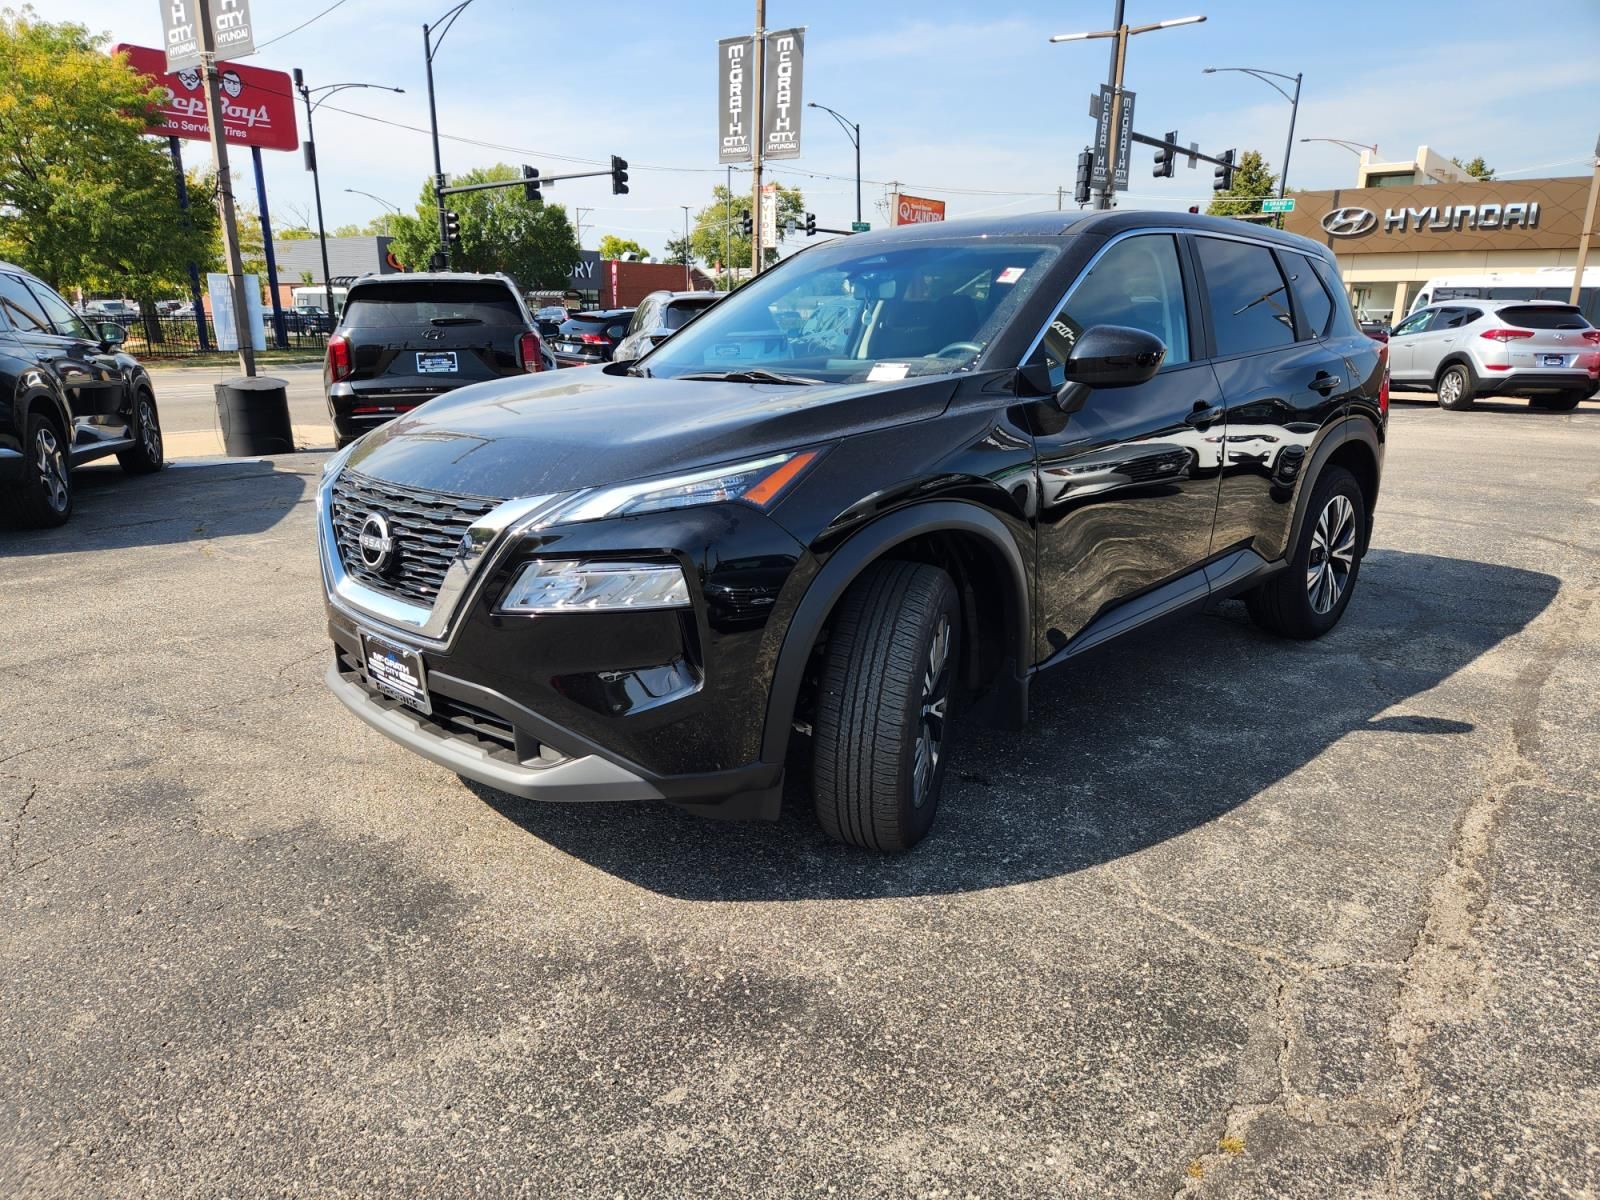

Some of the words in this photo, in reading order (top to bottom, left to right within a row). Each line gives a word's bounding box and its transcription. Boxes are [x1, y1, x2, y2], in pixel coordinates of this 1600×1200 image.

[216, 10, 244, 29] CITY
[168, 24, 193, 43] CITY
[217, 28, 248, 43] HYUNDAI
[169, 41, 196, 57] HYUNDAI
[181, 120, 210, 133] Servic
[224, 126, 247, 138] Tires
[769, 131, 796, 143] CITY
[723, 135, 747, 146] CITY
[1384, 202, 1540, 232] HYUNDAI
